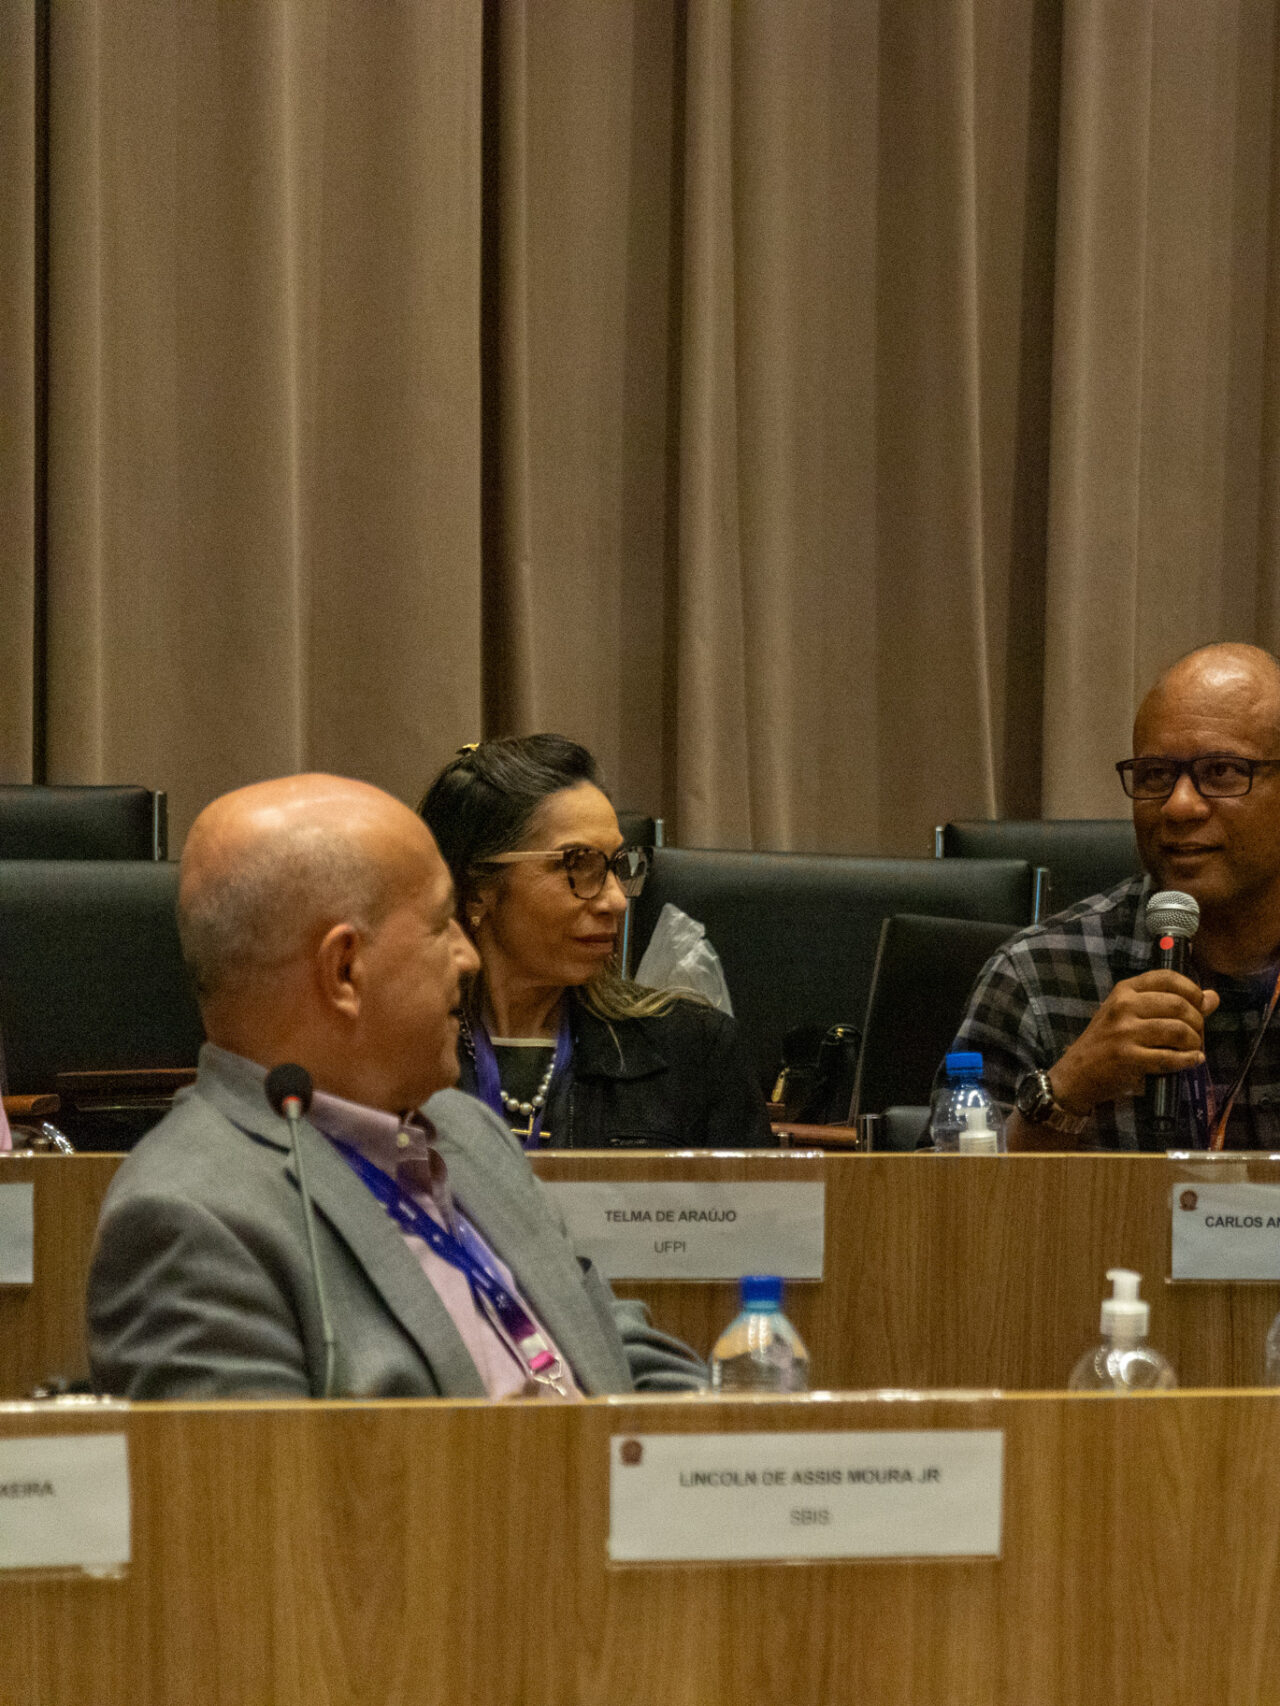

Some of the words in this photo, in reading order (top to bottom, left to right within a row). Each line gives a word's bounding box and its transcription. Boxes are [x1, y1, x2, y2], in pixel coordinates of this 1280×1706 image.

[604, 1210, 651, 1223] TELMA
[655, 1210, 675, 1223] DE
[678, 1207, 737, 1223] ARAÚJO
[1204, 1216, 1263, 1229] CARLOS
[653, 1241, 686, 1254] UFPI
[679, 1470, 758, 1488] LINCOLN
[761, 1470, 786, 1487] DE
[791, 1469, 843, 1486] ASSIS
[847, 1468, 914, 1485] MOURA
[918, 1467, 941, 1484] JR
[790, 1509, 831, 1527] SBIS
